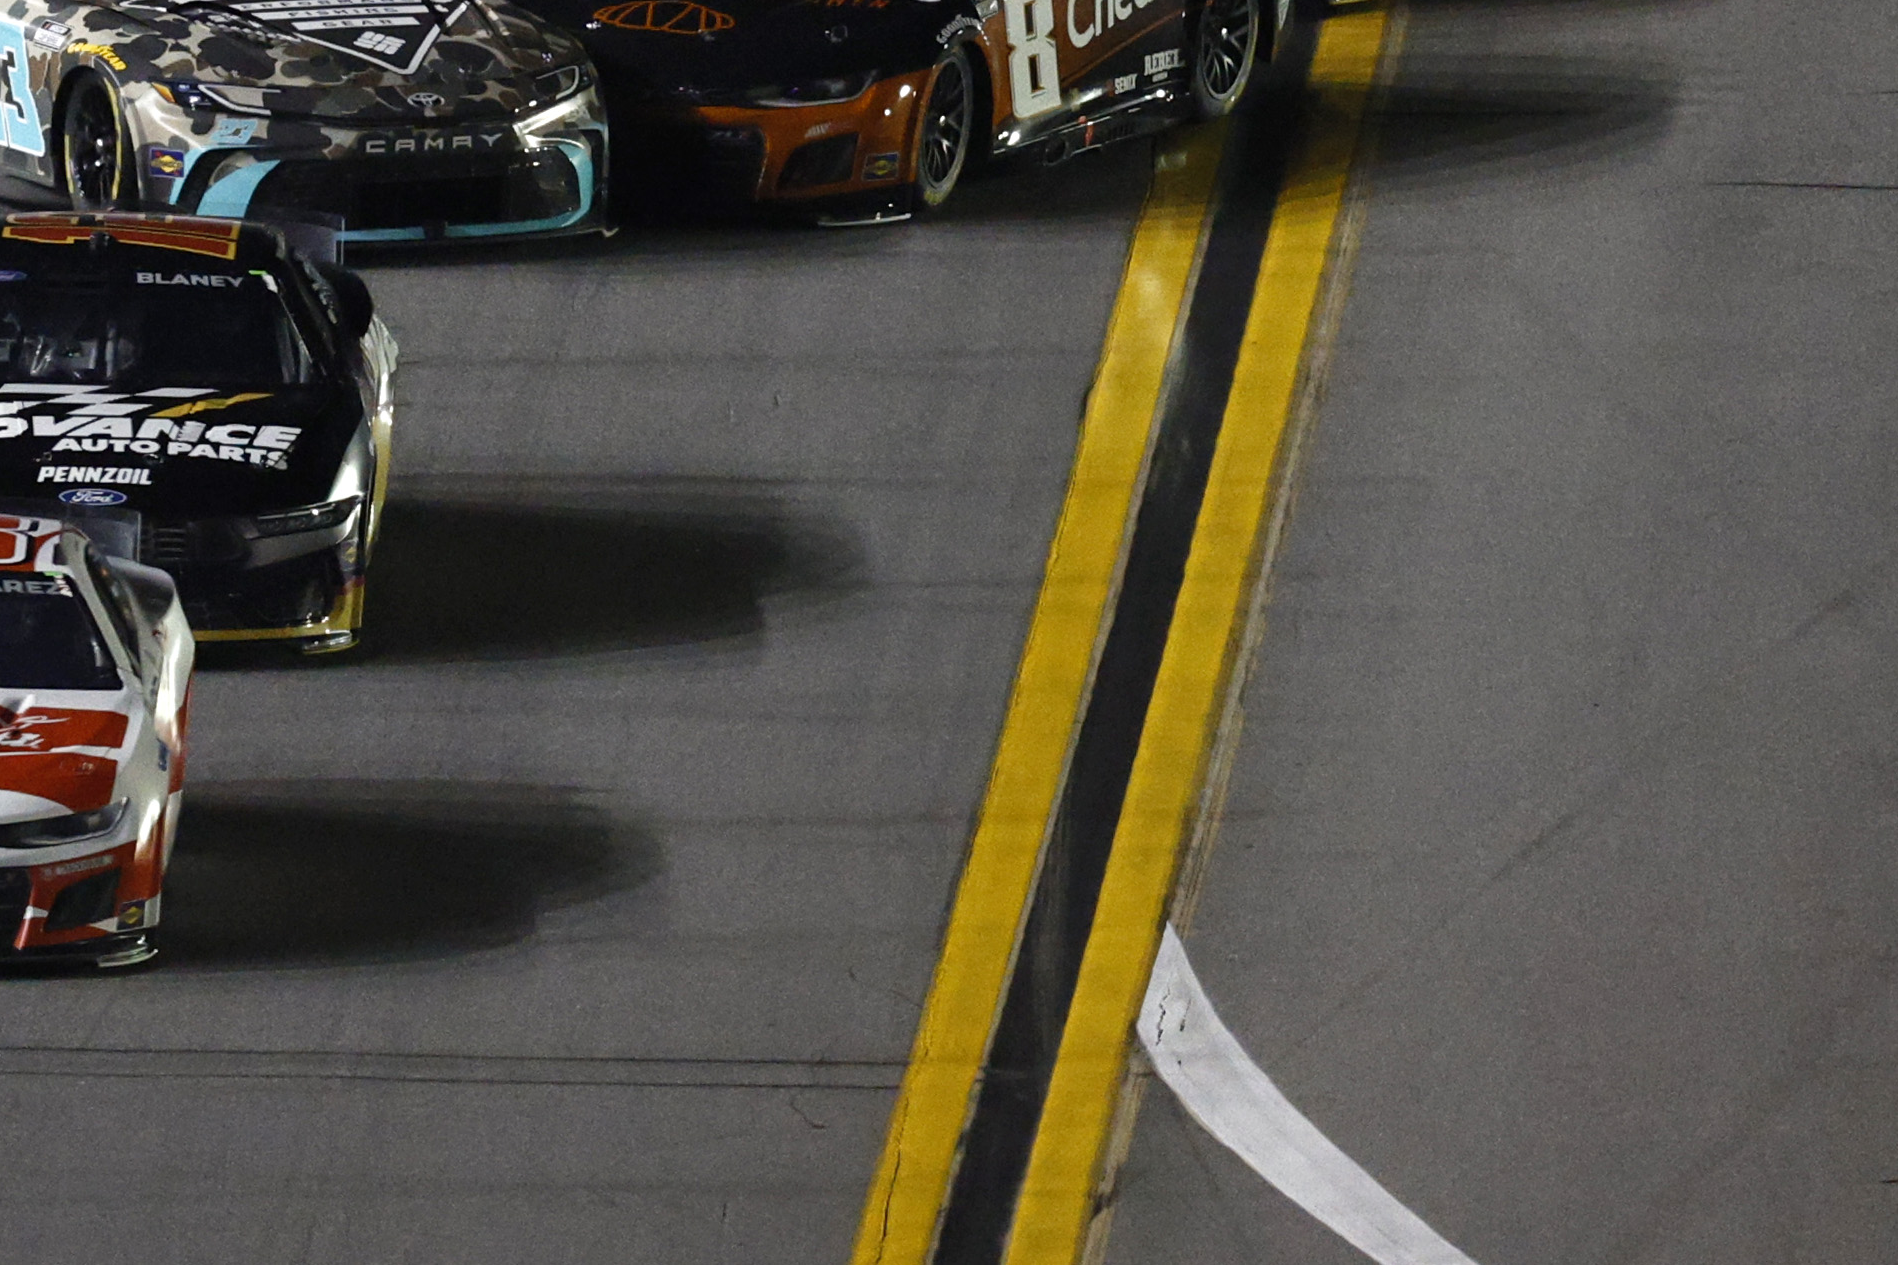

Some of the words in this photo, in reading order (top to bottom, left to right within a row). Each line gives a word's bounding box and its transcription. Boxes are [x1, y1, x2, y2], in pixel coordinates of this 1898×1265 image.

[365, 133, 502, 154] CAMRY
[136, 272, 243, 288] BLANEY
[52, 436, 158, 456] AUTO
[167, 440, 289, 471] PARTS
[37, 465, 152, 486] PENNZOIL
